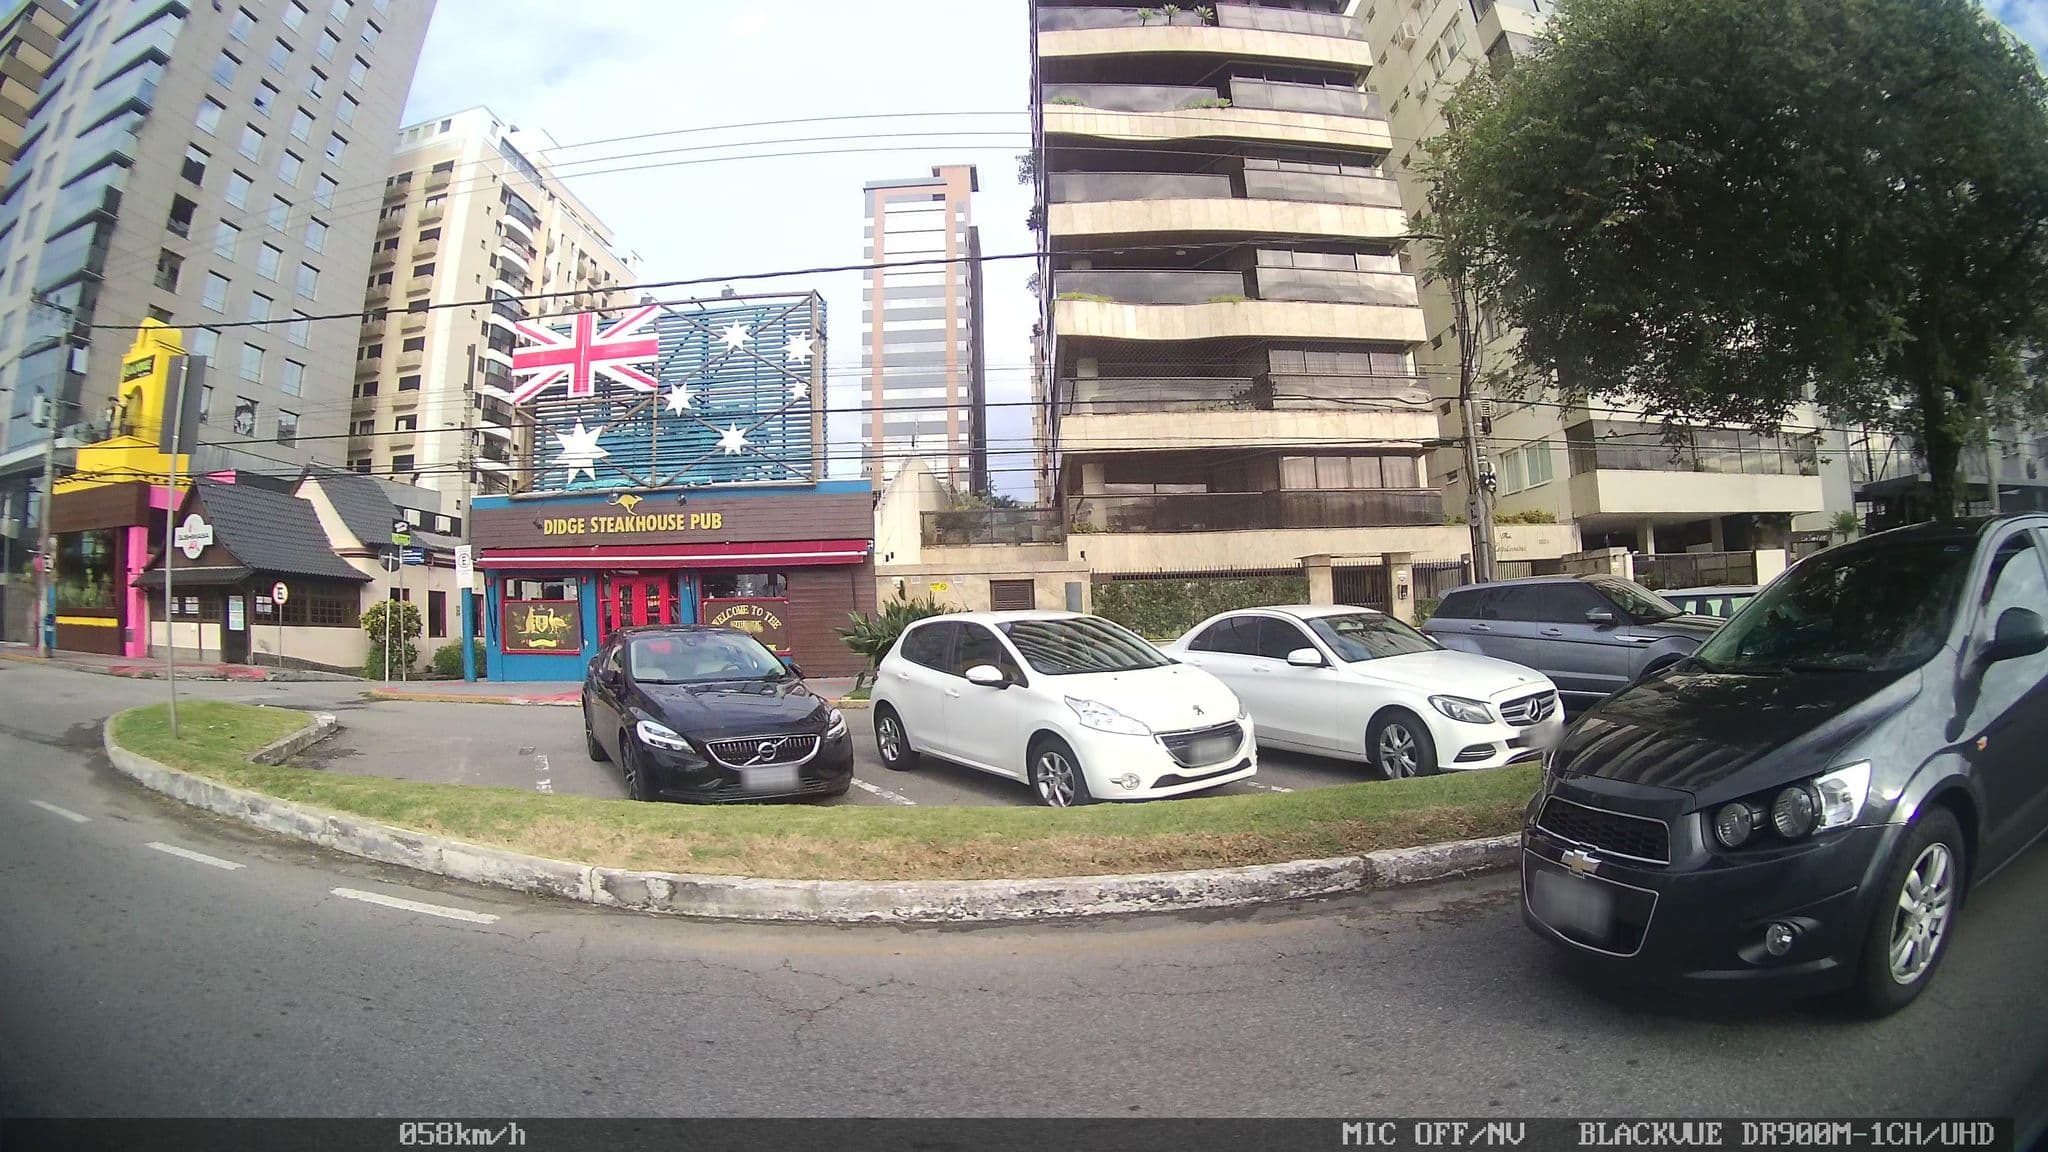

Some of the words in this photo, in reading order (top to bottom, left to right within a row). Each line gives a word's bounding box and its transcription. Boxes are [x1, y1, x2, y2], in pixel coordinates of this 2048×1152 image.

[543, 517, 585, 535] DIDGE
[590, 513, 685, 533] STEAKHOUSE
[690, 512, 722, 530] PUB
[277, 586, 284, 600] E
[711, 604, 749, 625] WELCOME
[751, 605, 764, 616] TO
[763, 611, 782, 630] THE
